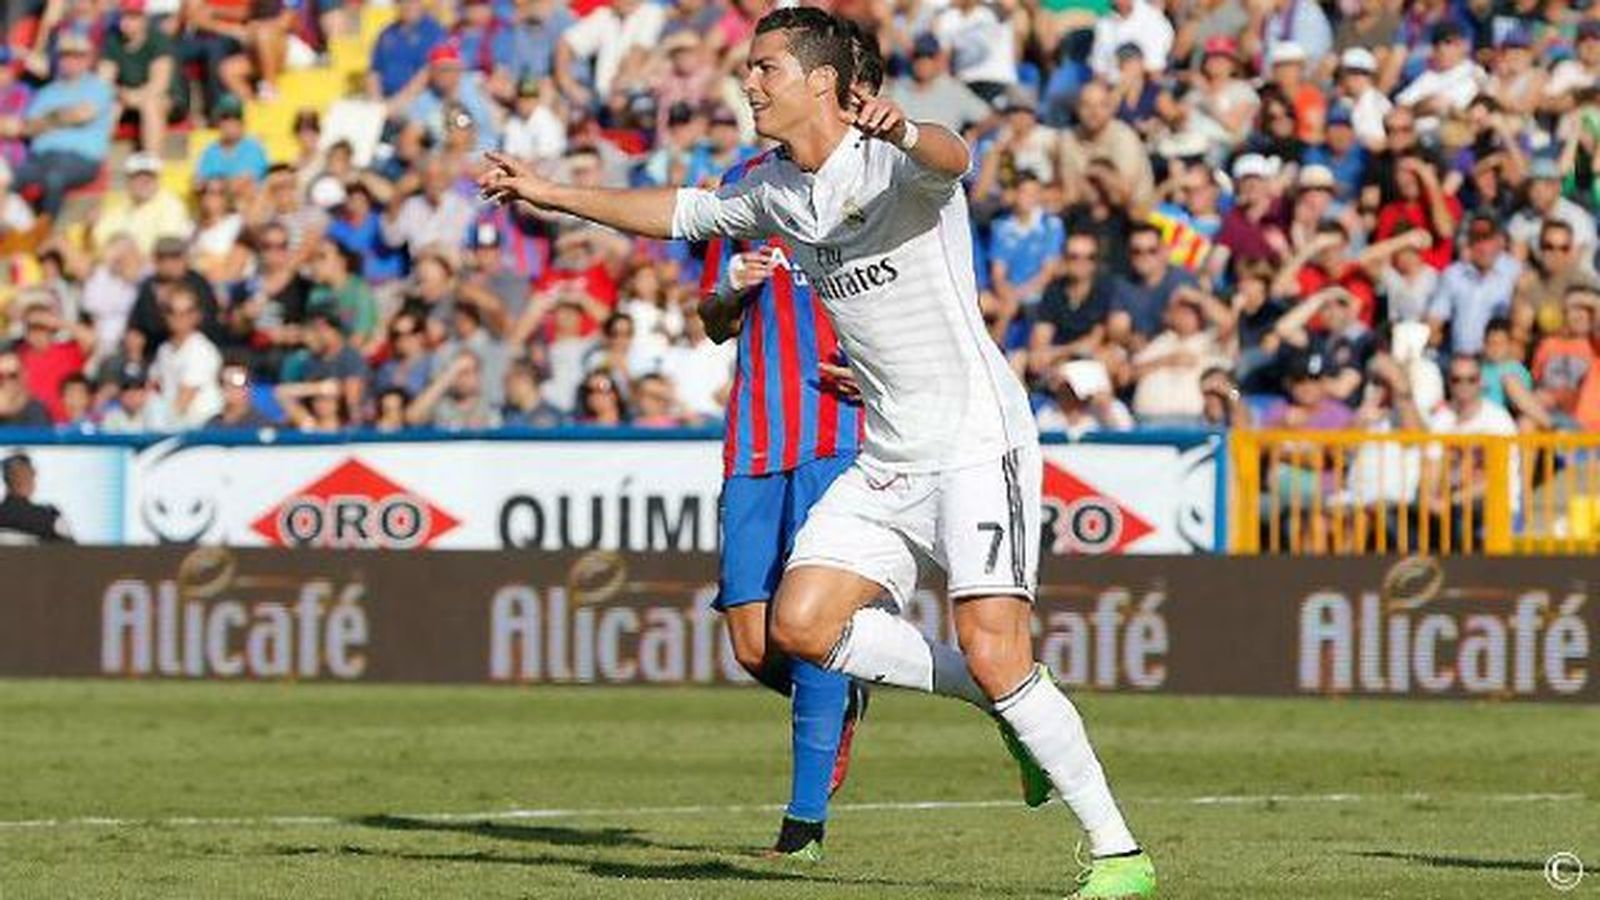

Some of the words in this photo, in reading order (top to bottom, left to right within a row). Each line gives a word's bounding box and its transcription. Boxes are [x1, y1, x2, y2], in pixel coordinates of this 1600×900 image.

[820, 257, 899, 300] irates
[286, 502, 421, 543] ORO
[499, 476, 721, 550] QUÍM
[1041, 504, 1114, 547] RO
[976, 521, 1005, 575] 7
[101, 578, 368, 678] Alicafé
[1299, 590, 1590, 693] Alicafé
